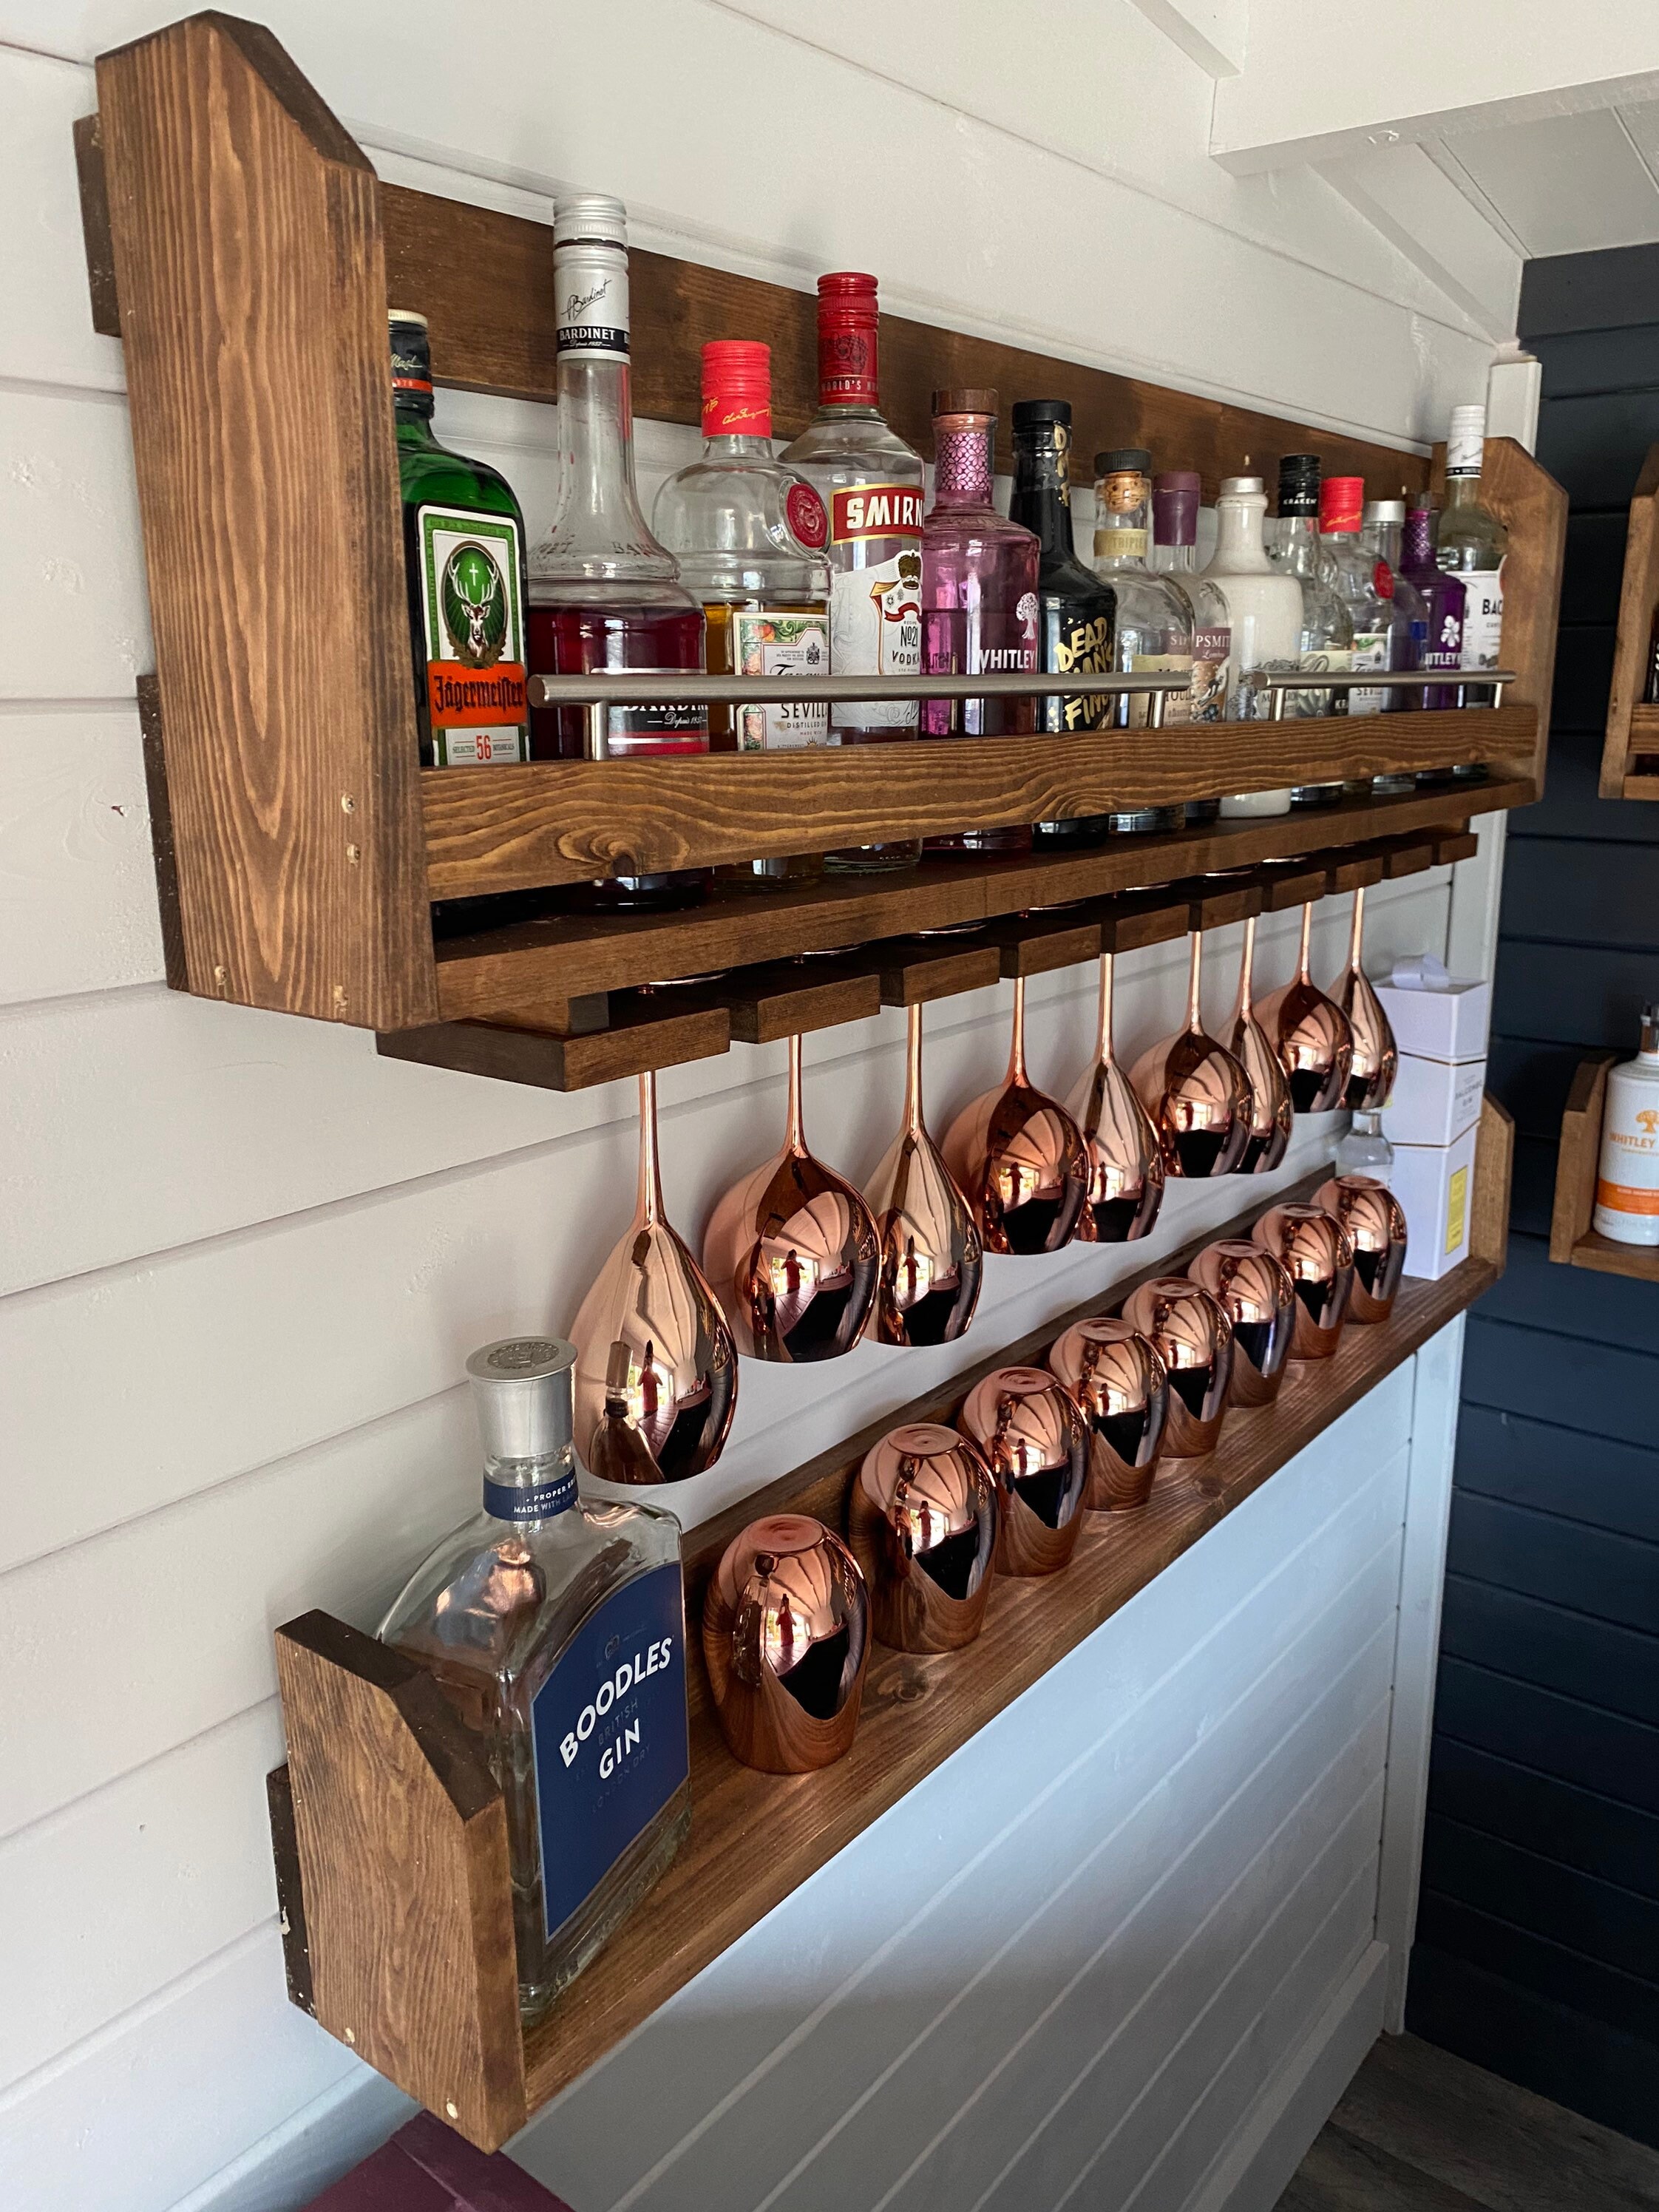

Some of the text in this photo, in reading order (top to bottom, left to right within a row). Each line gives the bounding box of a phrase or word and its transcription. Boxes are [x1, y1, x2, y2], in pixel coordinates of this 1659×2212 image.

[560, 328, 615, 340] BARDINET
[1054, 617, 1107, 672] DEAD
[475, 735, 492, 760] 56
[1609, 1132, 1655, 1148] WHITLEY
[534, 1486, 566, 1502] PROPER
[514, 1499, 560, 1513] MADE WITH
[559, 1637, 672, 1768] BOODLES
[600, 1718, 639, 1779] GIN
